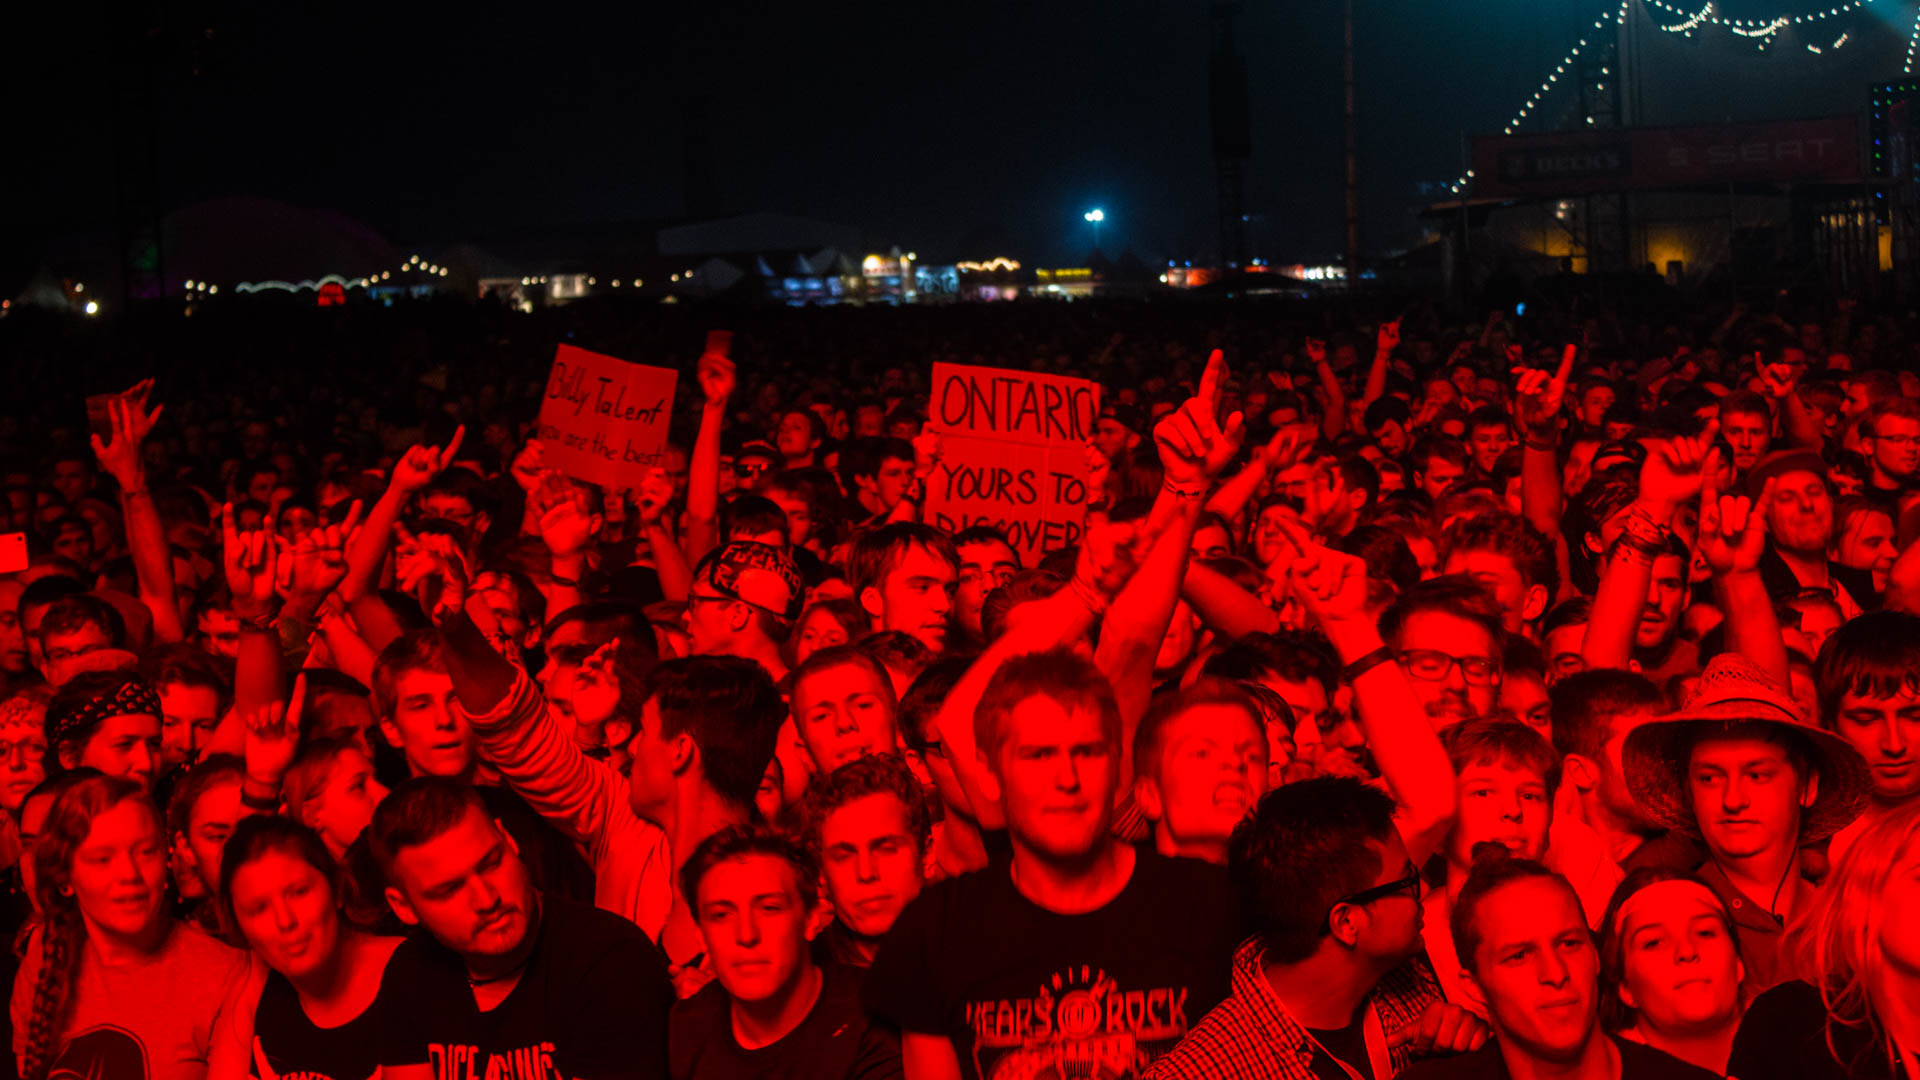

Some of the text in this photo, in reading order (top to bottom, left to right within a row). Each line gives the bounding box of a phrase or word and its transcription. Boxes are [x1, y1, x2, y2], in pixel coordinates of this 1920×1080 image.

[1706, 138, 1834, 164] SEAT
[549, 361, 665, 425] Billy Talent
[940, 375, 1097, 442] ONTARIO
[591, 432, 617, 461] the
[623, 438, 664, 465] best
[942, 463, 1086, 506] YOURS TO
[936, 511, 1081, 552] DIOVER
[1106, 986, 1188, 1034] ROCK
